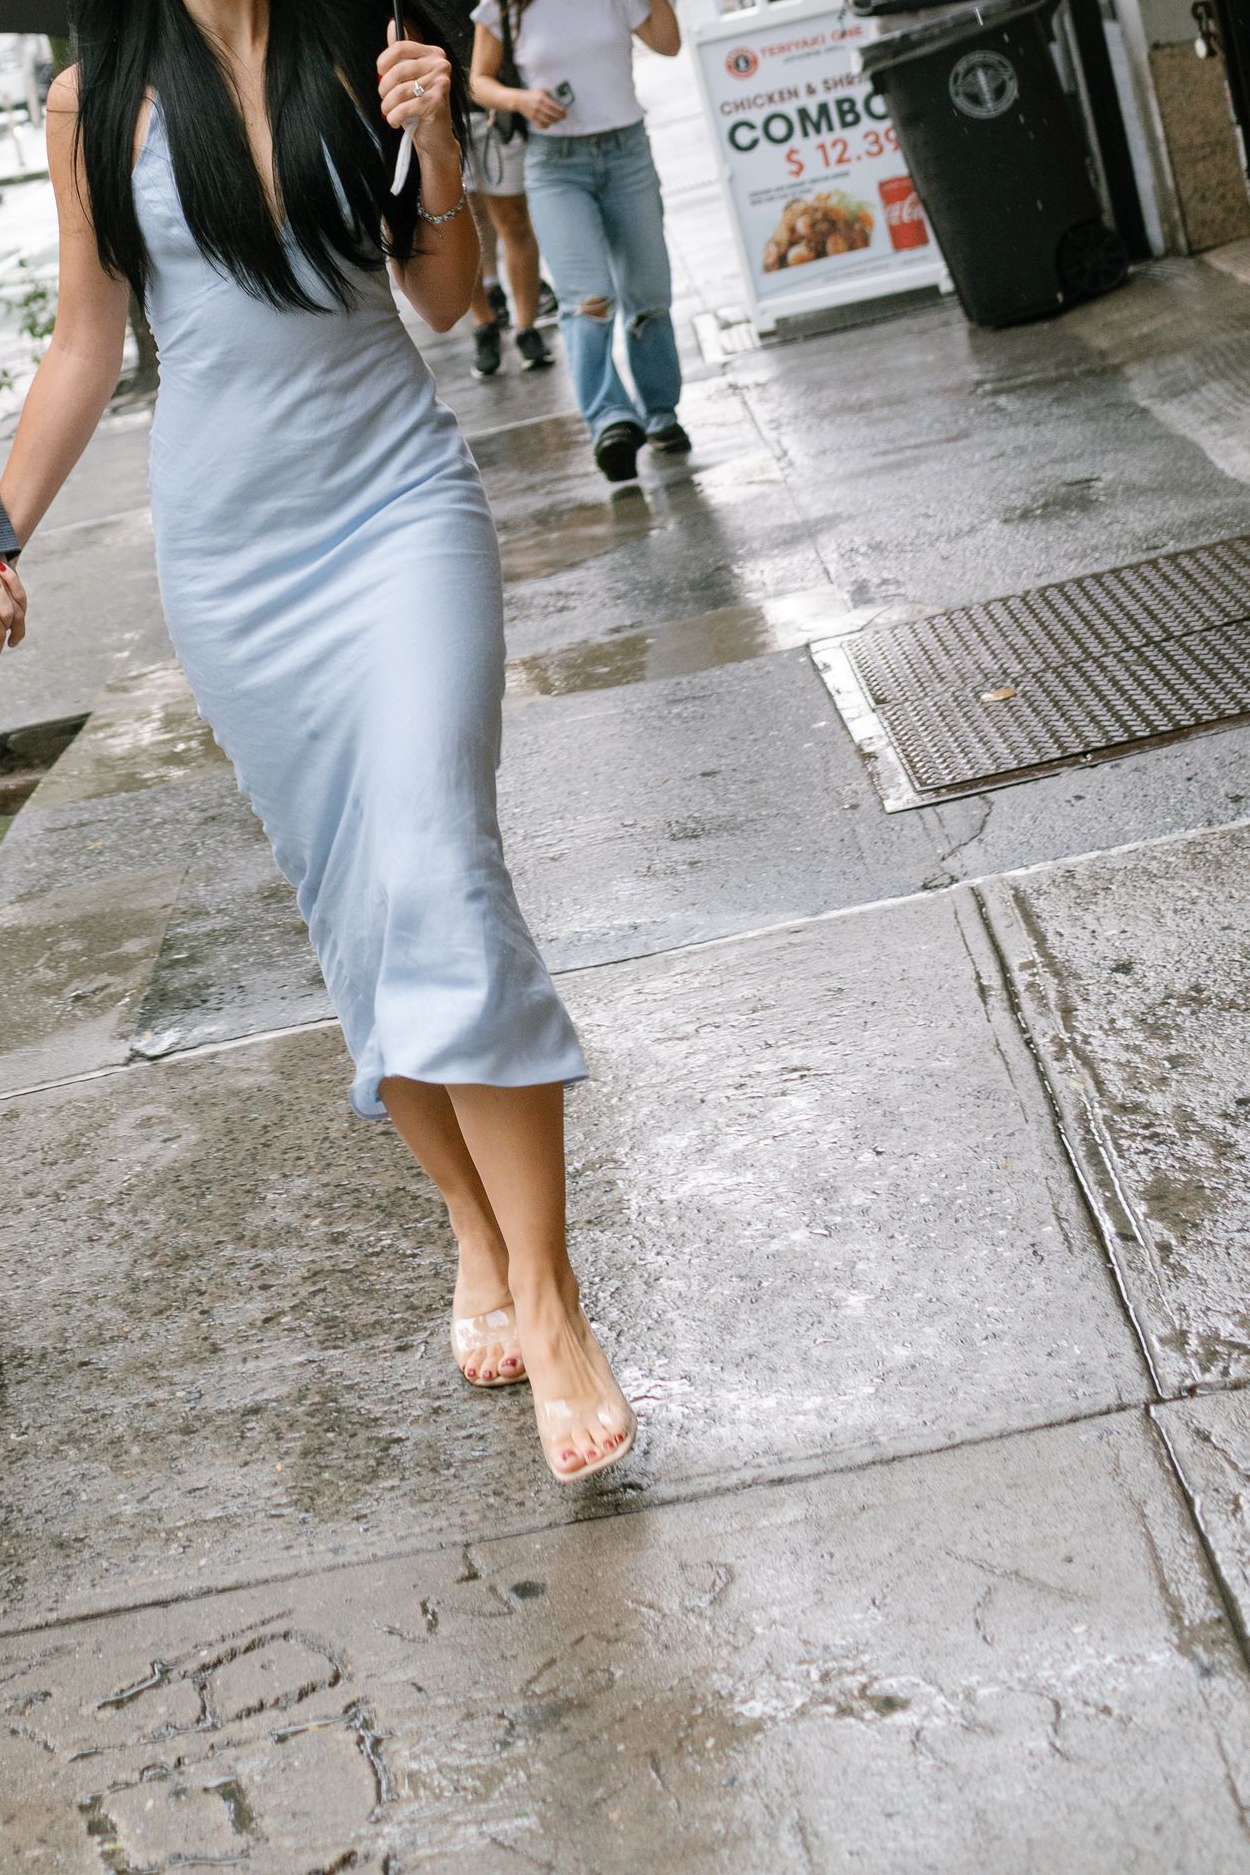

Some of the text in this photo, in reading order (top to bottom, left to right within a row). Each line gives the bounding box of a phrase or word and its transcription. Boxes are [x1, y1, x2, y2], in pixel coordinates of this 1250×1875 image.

[760, 34, 827, 58] TERIYAKI
[720, 84, 799, 116] CHICKEN
[806, 82, 817, 96] &
[728, 91, 890, 151] COMBO
[785, 147, 805, 178] $
